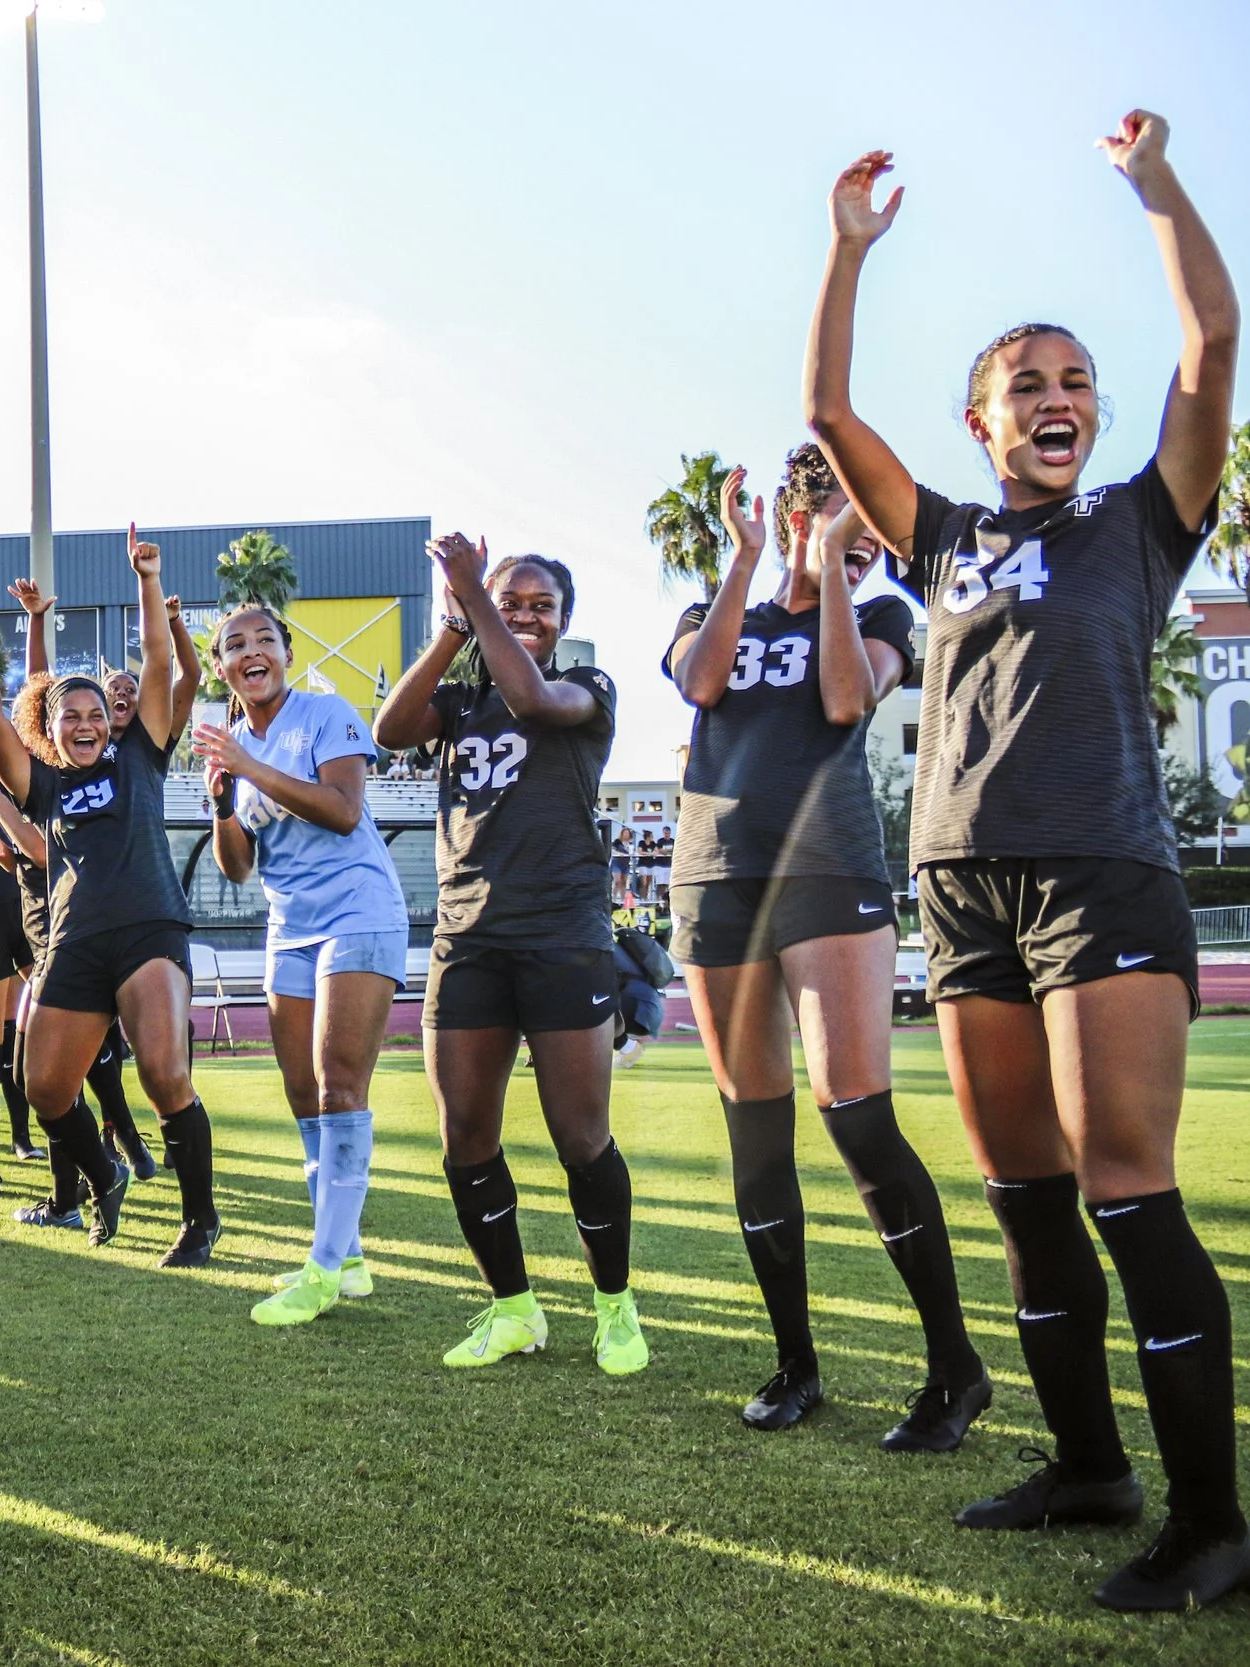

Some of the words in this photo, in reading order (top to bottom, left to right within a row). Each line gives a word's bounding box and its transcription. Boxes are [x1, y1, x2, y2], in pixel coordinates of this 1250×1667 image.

[943, 540, 1049, 614] 34
[727, 636, 811, 691] 33
[456, 733, 527, 791] 32
[61, 779, 113, 815] 29
